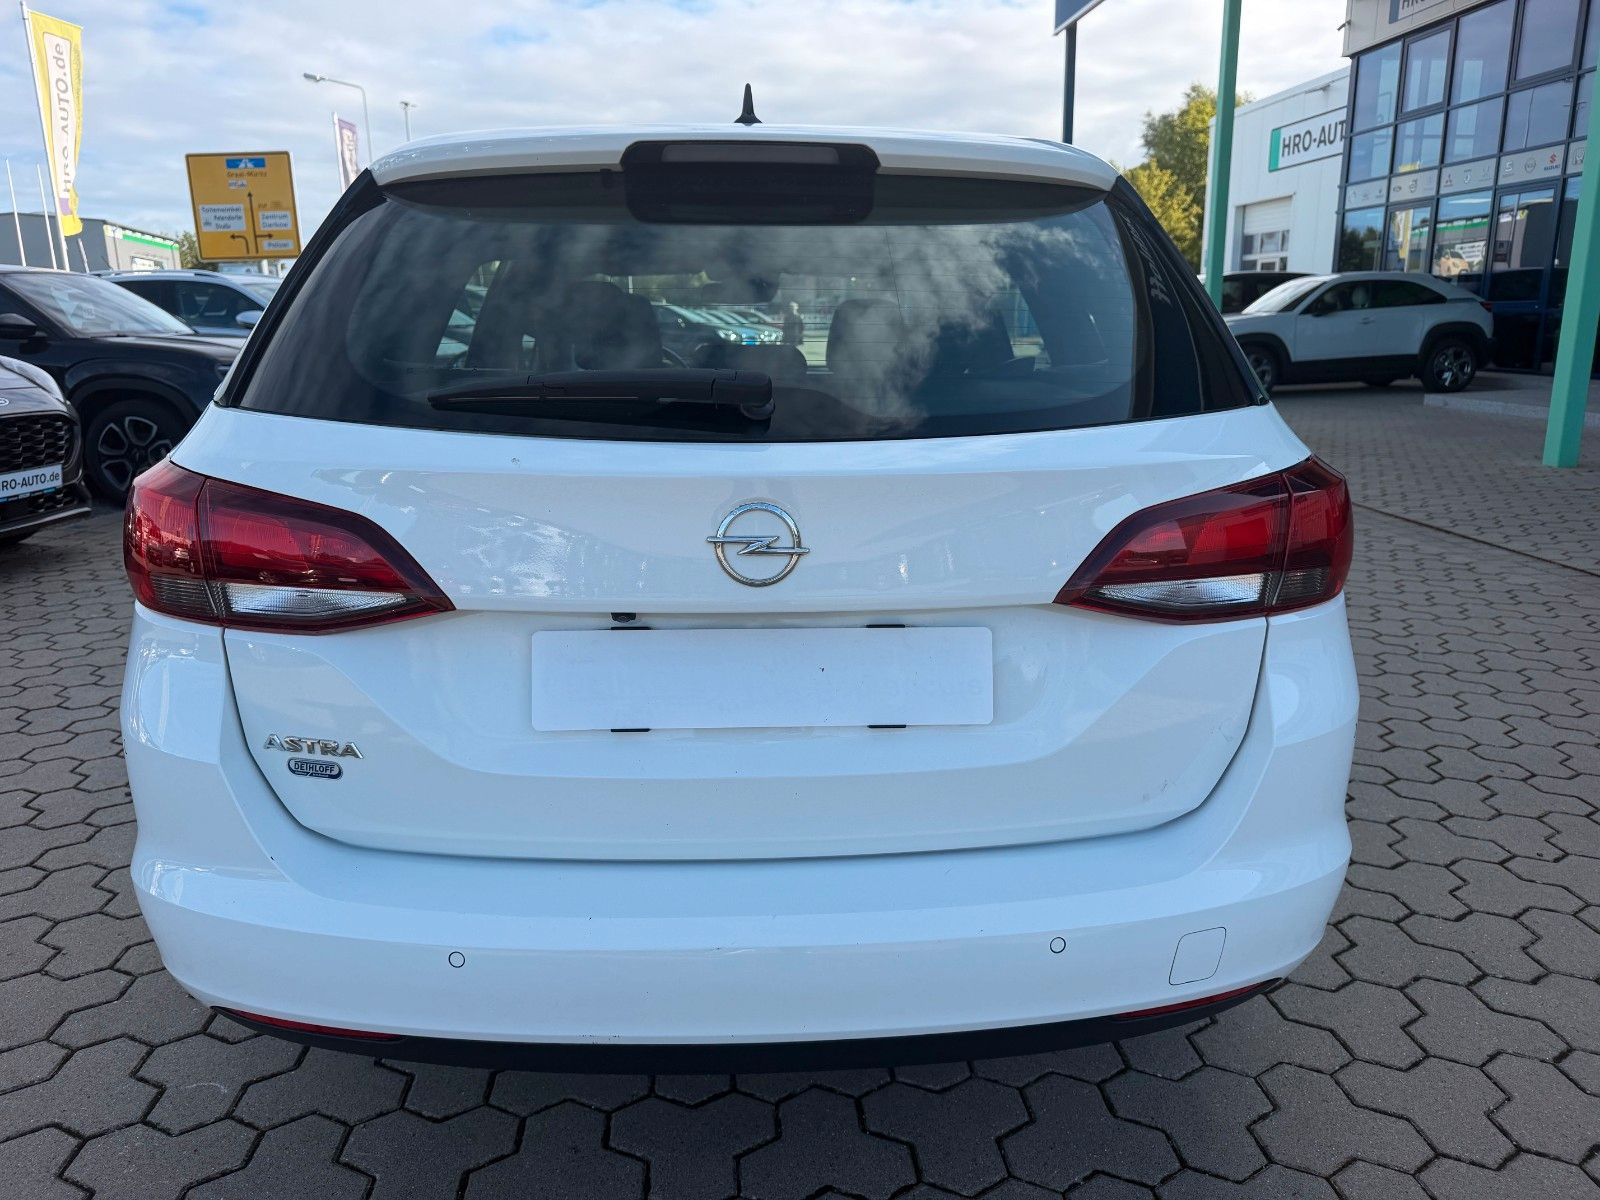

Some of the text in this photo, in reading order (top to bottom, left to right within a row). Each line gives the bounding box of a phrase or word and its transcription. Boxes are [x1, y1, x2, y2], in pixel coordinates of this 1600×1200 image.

[53, 42, 71, 194] HROAUTO.de
[0, 471, 60, 491] RO-AUTO.de
[263, 733, 364, 759] ASTRA
[294, 761, 335, 774] DETHLOFF
